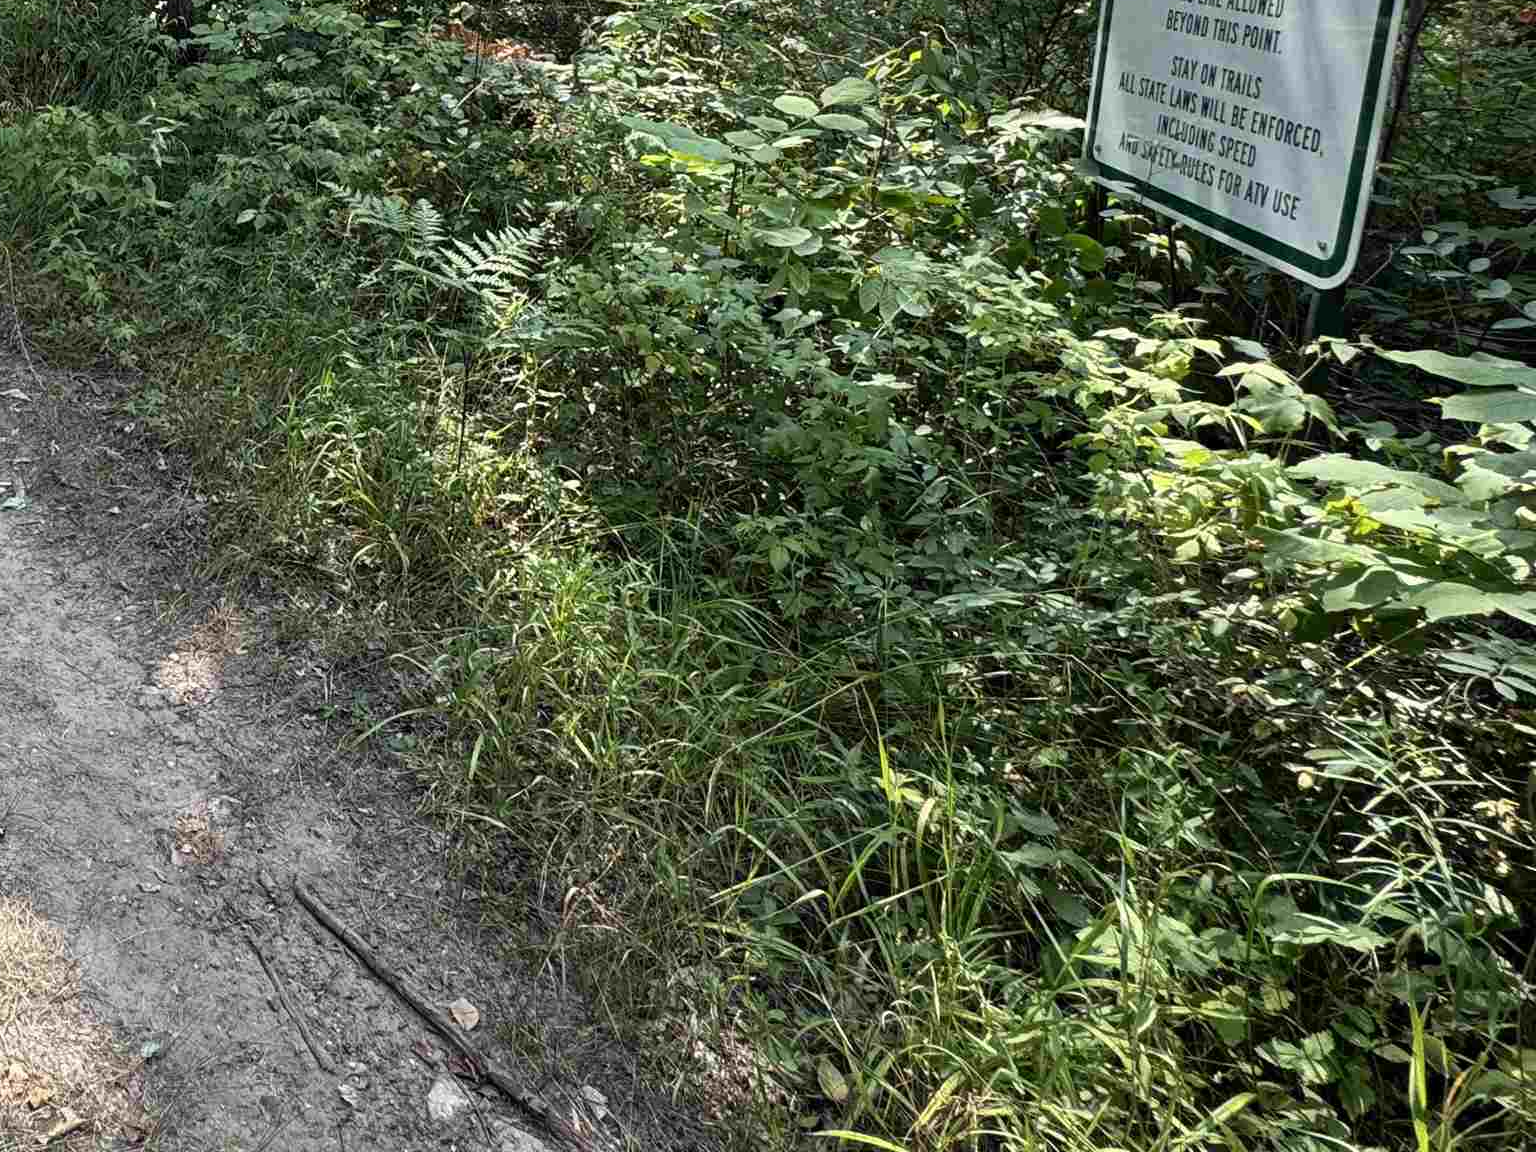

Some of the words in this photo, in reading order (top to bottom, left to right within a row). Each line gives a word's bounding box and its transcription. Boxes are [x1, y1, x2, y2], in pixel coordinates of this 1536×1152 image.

[1166, 9, 1209, 38] BEYOND
[1213, 18, 1239, 44] THIS
[1242, 24, 1282, 55] POINT.
[1119, 71, 1135, 95] ALL
[1138, 77, 1167, 104] STATE
[1169, 86, 1198, 114] LAWS
[1200, 96, 1226, 124] WILL
[1231, 105, 1249, 130] BE
[1170, 56, 1198, 81] STAY
[1200, 64, 1217, 87] ON
[1221, 68, 1262, 99] TRAILS
[1157, 114, 1216, 153] INCLUDING
[1218, 136, 1256, 167] SPEED
[1179, 154, 1215, 187] RULES
[1217, 168, 1243, 198] FOR
[1244, 180, 1269, 207] ATV
[1272, 188, 1300, 221] USE
